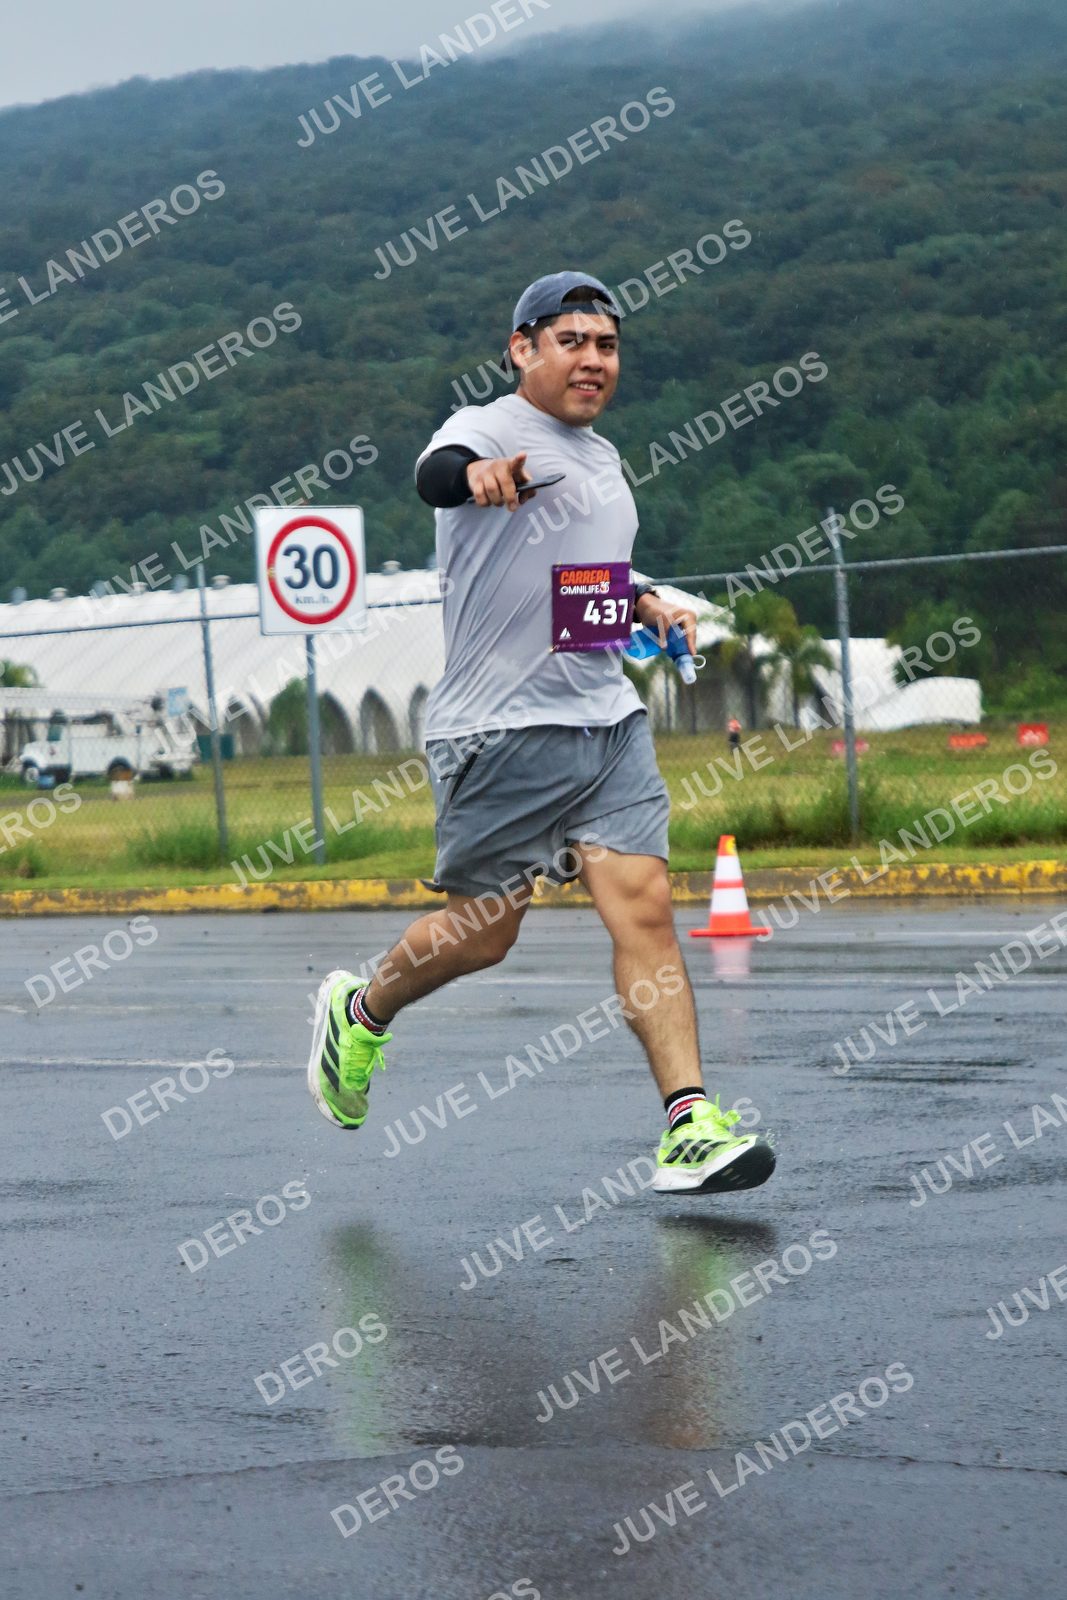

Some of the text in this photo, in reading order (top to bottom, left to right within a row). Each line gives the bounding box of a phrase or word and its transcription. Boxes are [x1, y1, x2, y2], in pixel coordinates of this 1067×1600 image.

[283, 543, 340, 590] 30
[560, 569, 611, 585] CARRERA
[560, 584, 600, 596] OMNILIFE
[583, 598, 629, 625] 437
